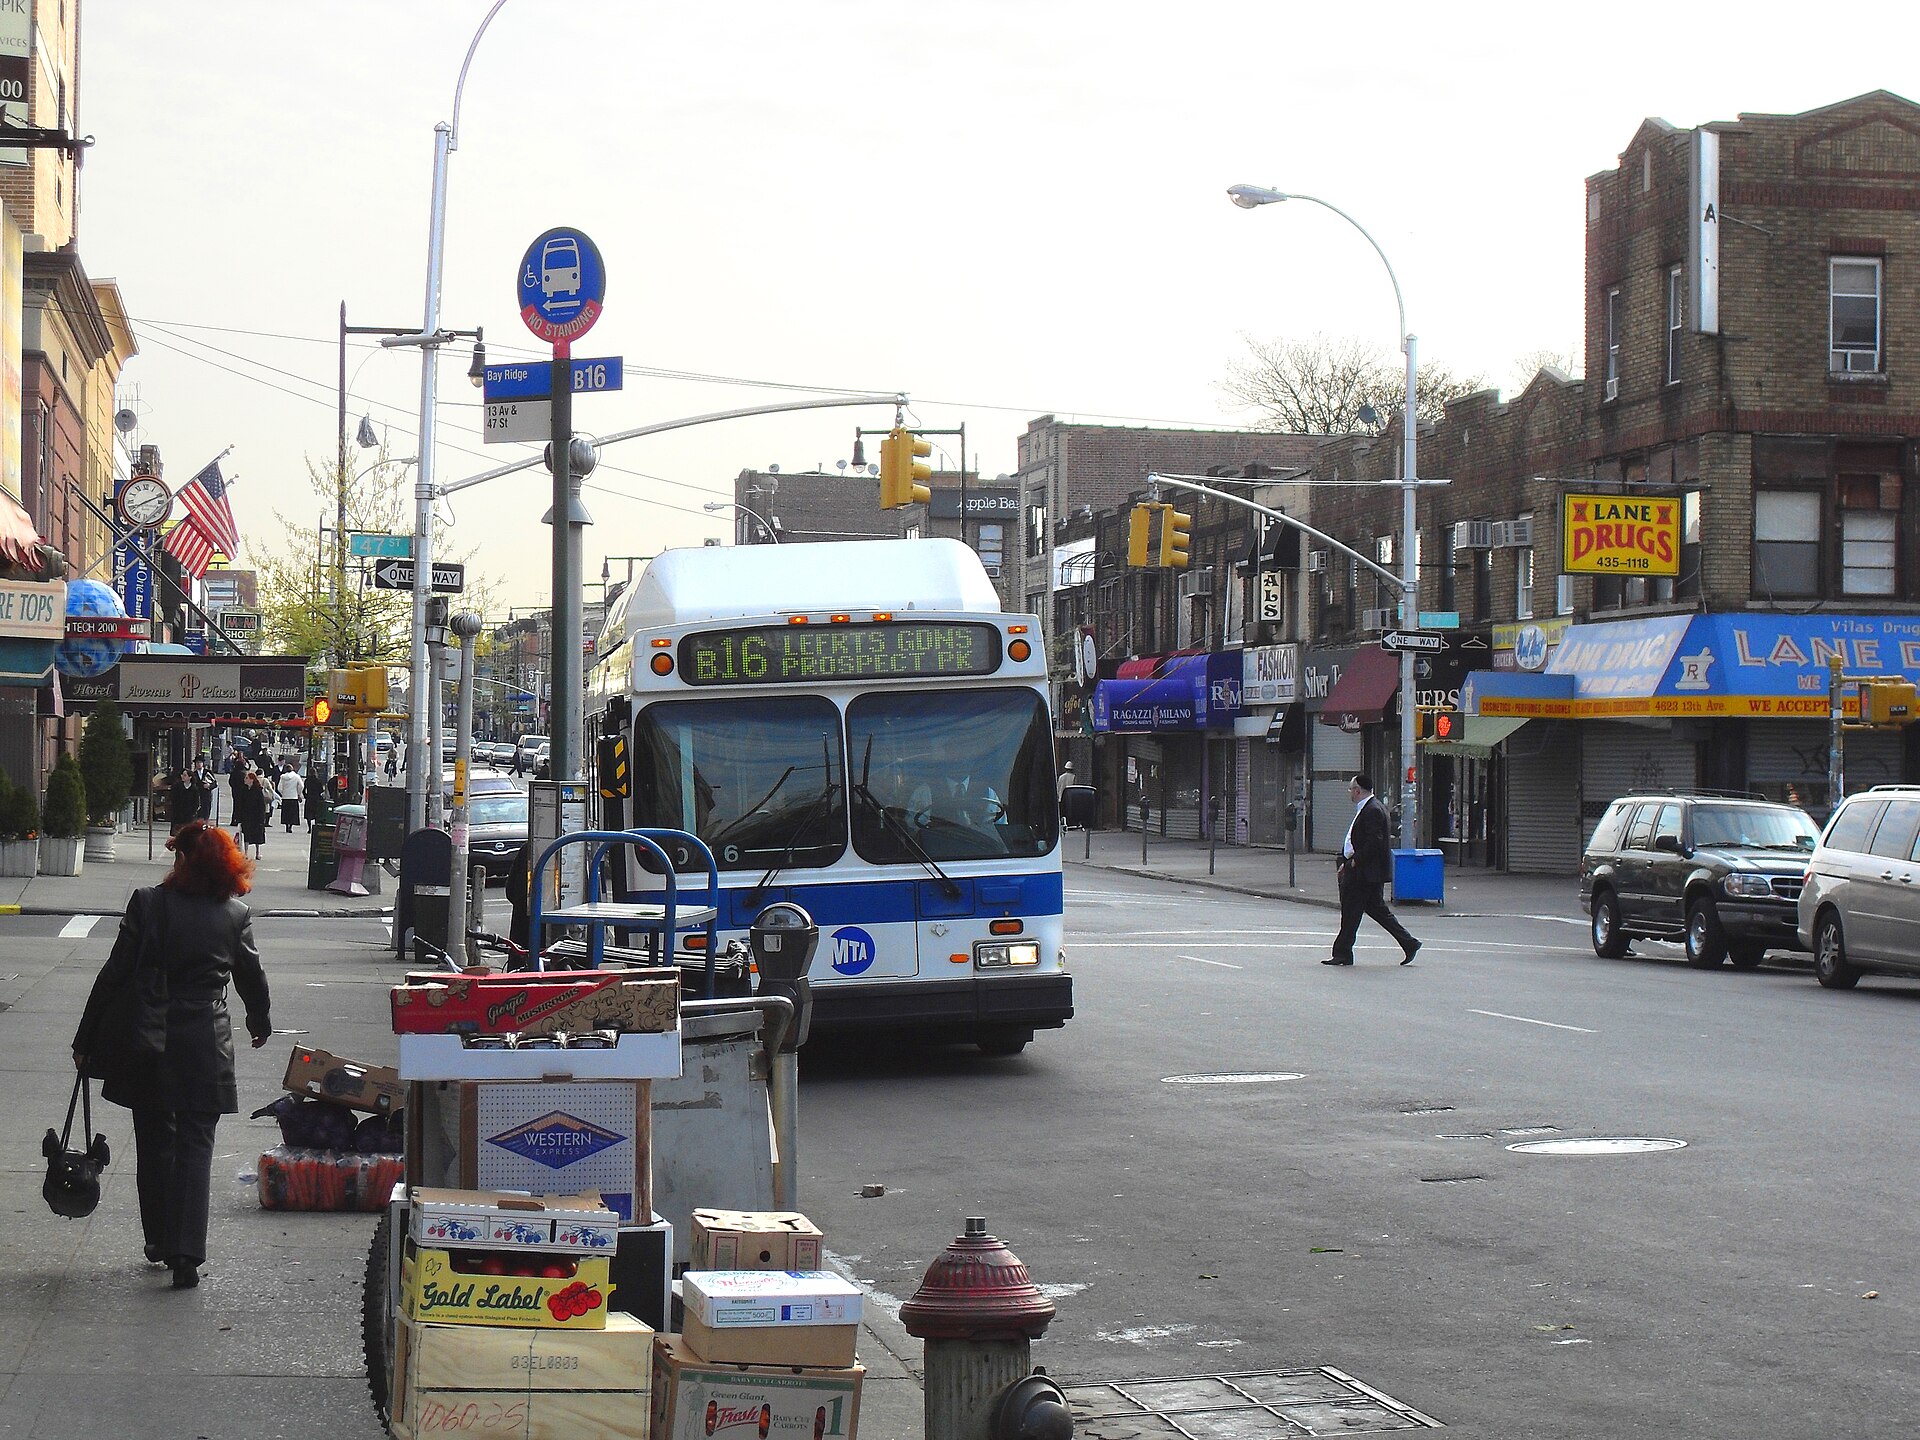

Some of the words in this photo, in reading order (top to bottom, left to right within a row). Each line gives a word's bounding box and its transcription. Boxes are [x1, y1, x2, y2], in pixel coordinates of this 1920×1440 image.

[1, 79, 23, 98] 00
[1703, 203, 1717, 224] A
[528, 312, 542, 331] NO
[545, 306, 595, 337] STANDING
[487, 370, 503, 383] Bay
[504, 369, 528, 381] Ridge
[574, 364, 606, 389] B16
[487, 406, 497, 416] 13
[499, 406, 509, 416] Av
[510, 405, 518, 415] &
[487, 419, 497, 428] 47
[499, 418, 508, 428] St
[1594, 503, 1652, 522] LANE
[360, 538, 385, 554] 47
[388, 538, 401, 547] ST
[1572, 523, 1673, 563] DRUGS
[1596, 556, 1649, 569] 435-1118
[389, 568, 414, 582] ONE
[432, 572, 458, 585] WAY
[20, 593, 54, 622] TOPS
[73, 623, 95, 633] TECH
[98, 622, 118, 633] 2000
[1831, 620, 1874, 633] Vilas
[1390, 635, 1409, 645] ONE
[1419, 637, 1437, 647] WAY
[1733, 629, 1883, 669] LANE
[696, 635, 767, 680] B16
[783, 630, 885, 655] LEFRTS
[897, 626, 974, 650] GDNS
[781, 652, 922, 677] PROSPECT
[937, 650, 974, 671] PK
[1257, 650, 1295, 681] FASHION
[73, 683, 116, 697] Hotel
[1304, 666, 1329, 699] Silver
[1797, 674, 1821, 691] WE
[125, 686, 172, 699] Avenue
[202, 685, 236, 699] Plaza
[243, 686, 299, 698] Restaurant
[338, 693, 356, 702] DEAR
[1655, 700, 1679, 712] 4623
[1682, 700, 1702, 712] 13th
[1706, 699, 1727, 712] Ave.
[1749, 699, 1771, 712] WE
[1777, 700, 1830, 712] ACCEPT
[1113, 708, 1152, 720] RAGAZZI
[1159, 708, 1191, 719] MILANO
[831, 936, 867, 967] MTA
[487, 990, 528, 1026] Giorgio
[516, 986, 581, 1023] MUSHROOMS
[524, 1132, 592, 1146] WESTERN
[535, 1147, 581, 1156] EXPRESS
[946, 1253, 983, 1264] OPEN
[419, 1281, 476, 1310] Gold
[477, 1286, 543, 1310] Label
[711, 1390, 738, 1400] Green
[738, 1391, 765, 1401] Giant
[717, 1405, 759, 1428] Fresh
[824, 1396, 846, 1436] 1
